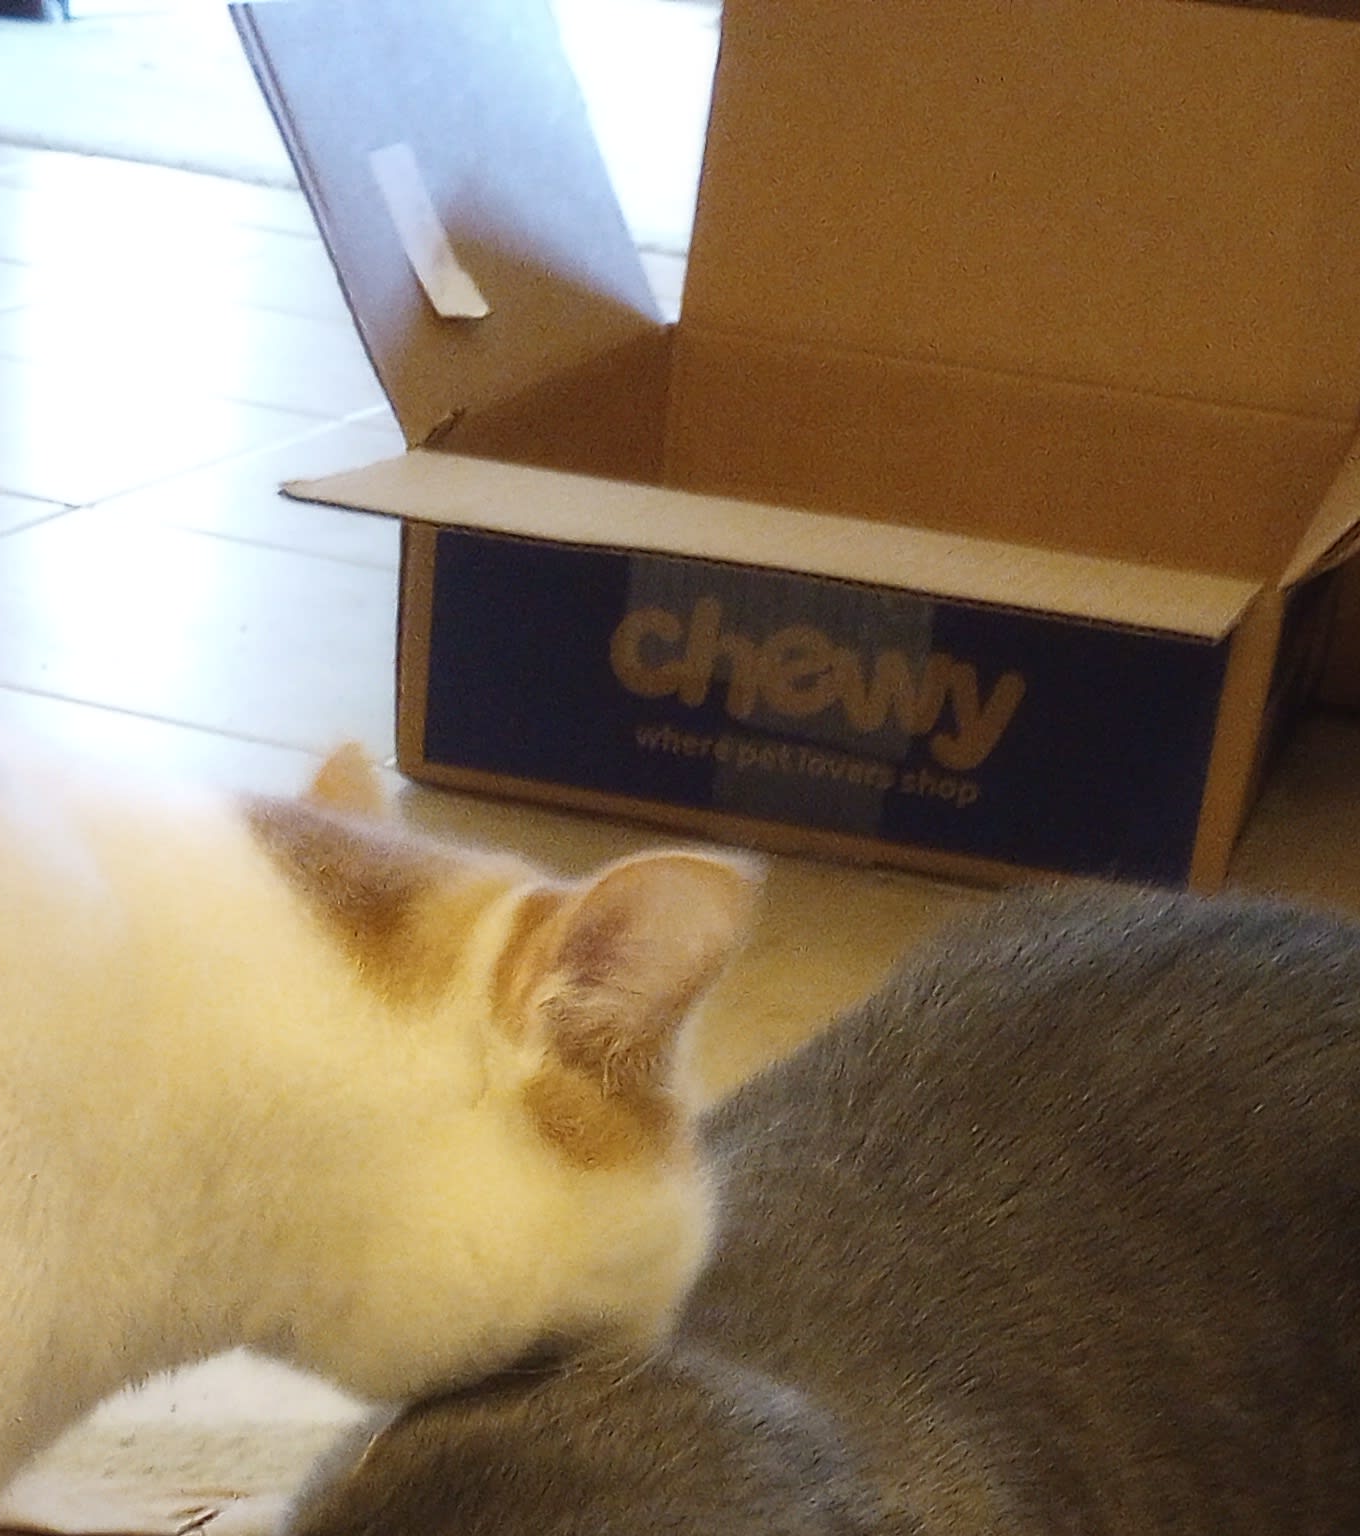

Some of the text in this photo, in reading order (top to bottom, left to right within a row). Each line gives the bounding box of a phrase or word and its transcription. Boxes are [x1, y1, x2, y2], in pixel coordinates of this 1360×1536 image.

[610, 599, 1025, 770] chewy
[635, 726, 979, 808] where pet lovers shop
